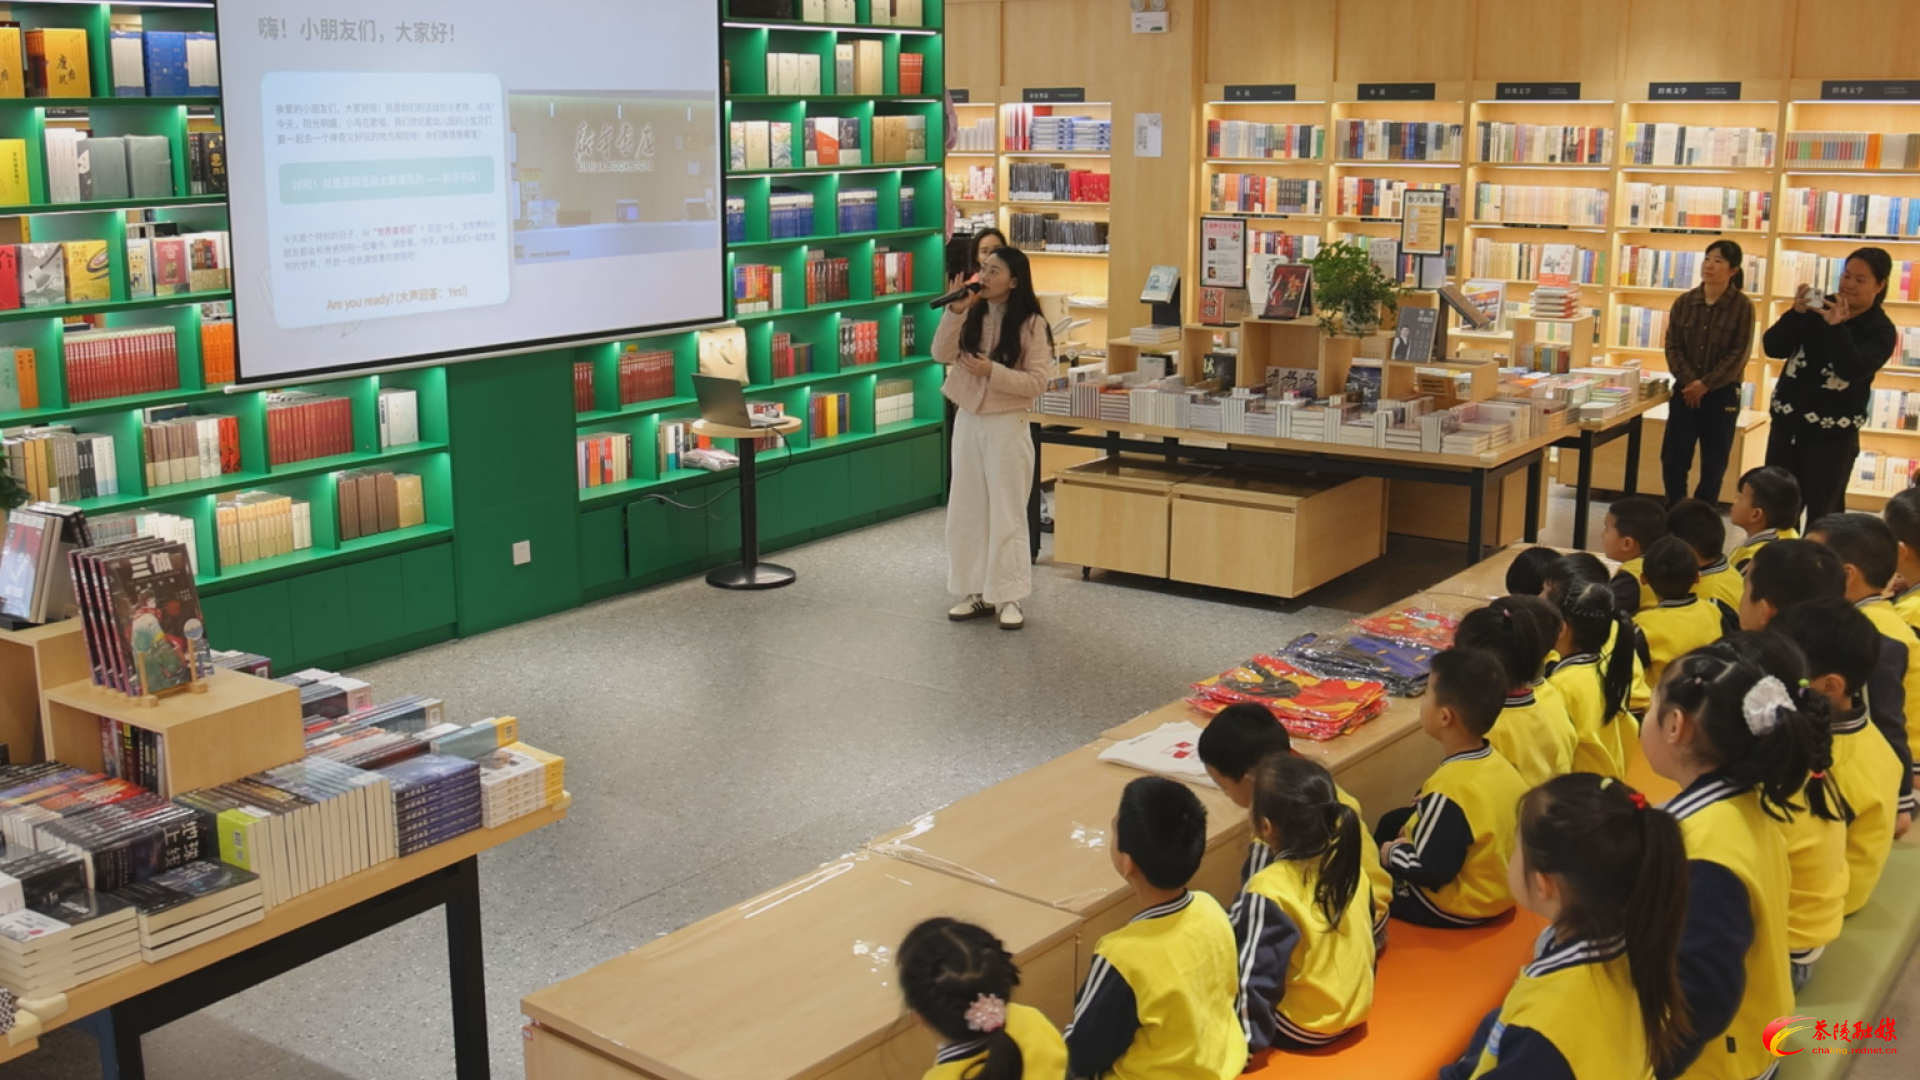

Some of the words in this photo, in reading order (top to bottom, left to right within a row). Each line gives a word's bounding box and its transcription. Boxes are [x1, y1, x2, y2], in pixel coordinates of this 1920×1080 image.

[326, 299, 343, 311] Are
[344, 298, 362, 312] you
[364, 293, 395, 307] ready?
[129, 552, 173, 579] 三体
